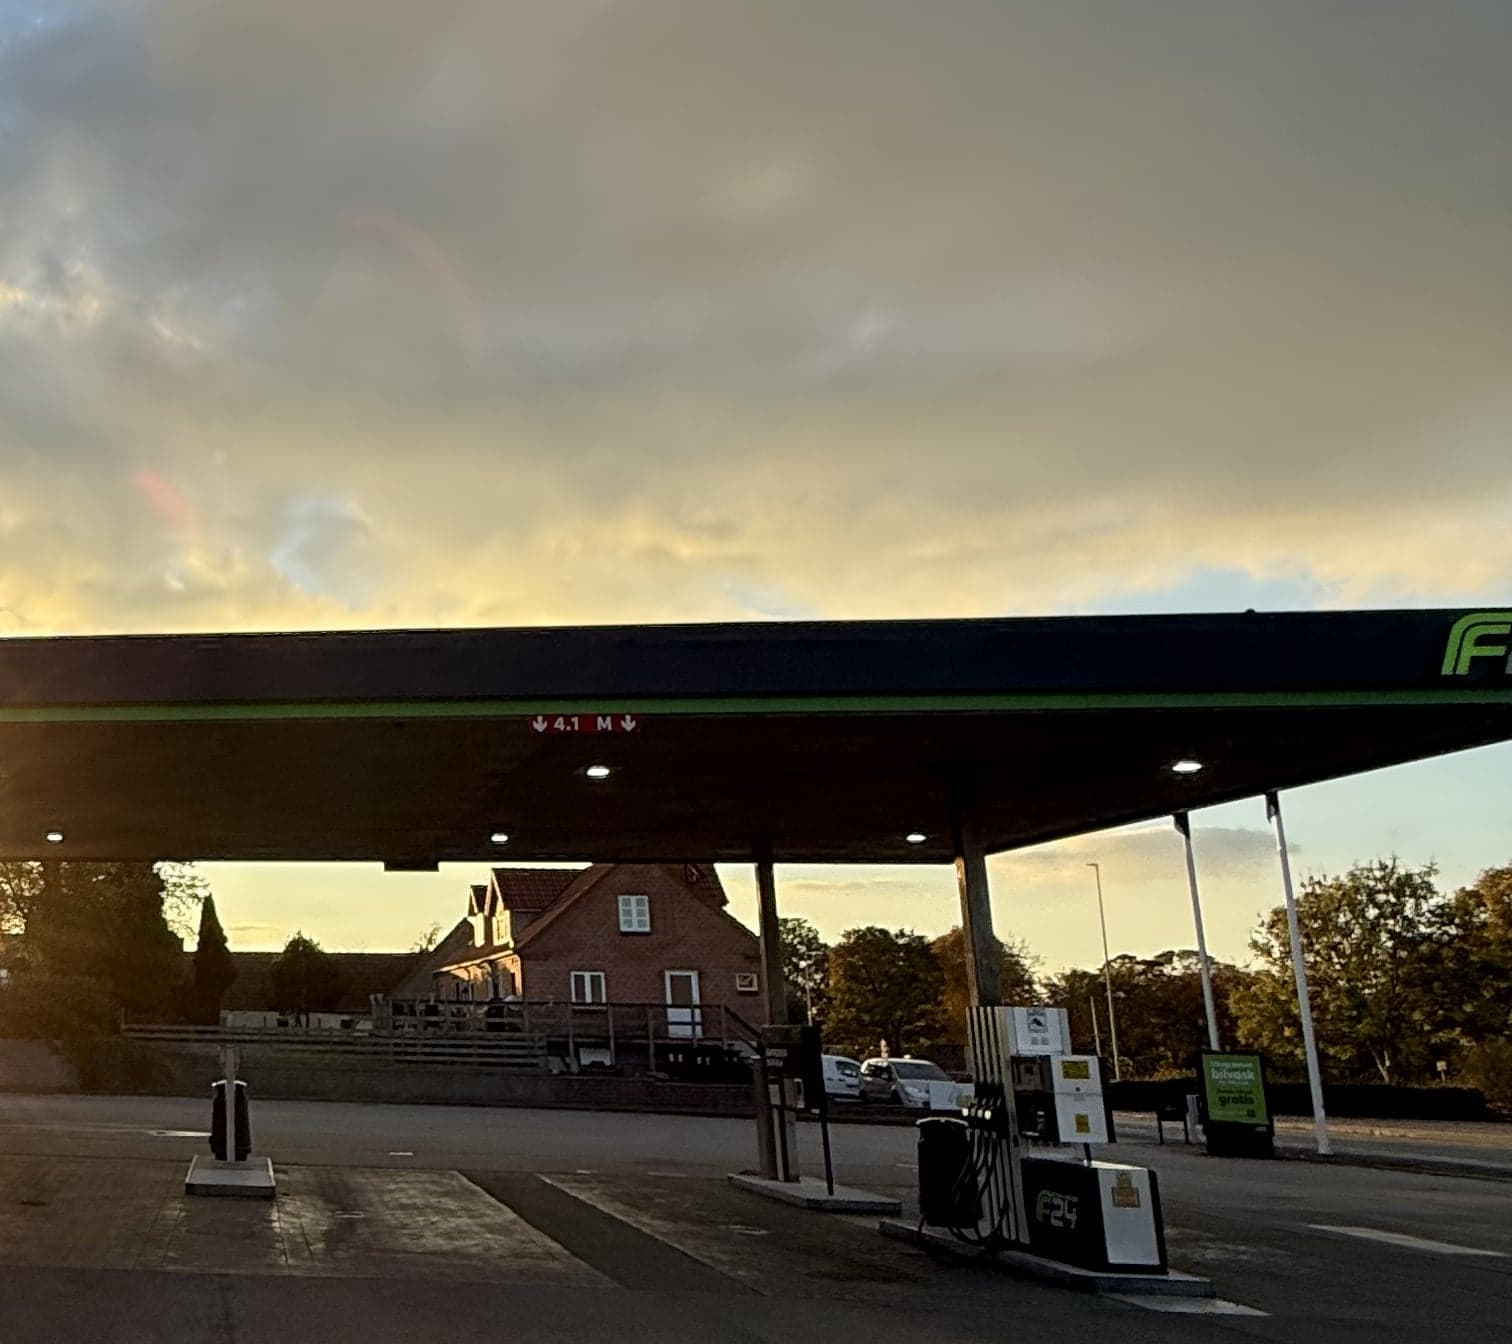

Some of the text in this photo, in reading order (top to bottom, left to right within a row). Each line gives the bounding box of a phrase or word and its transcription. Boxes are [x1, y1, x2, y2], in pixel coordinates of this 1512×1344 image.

[1440, 612, 1512, 675] F
[553, 715, 613, 731] 4.1 M
